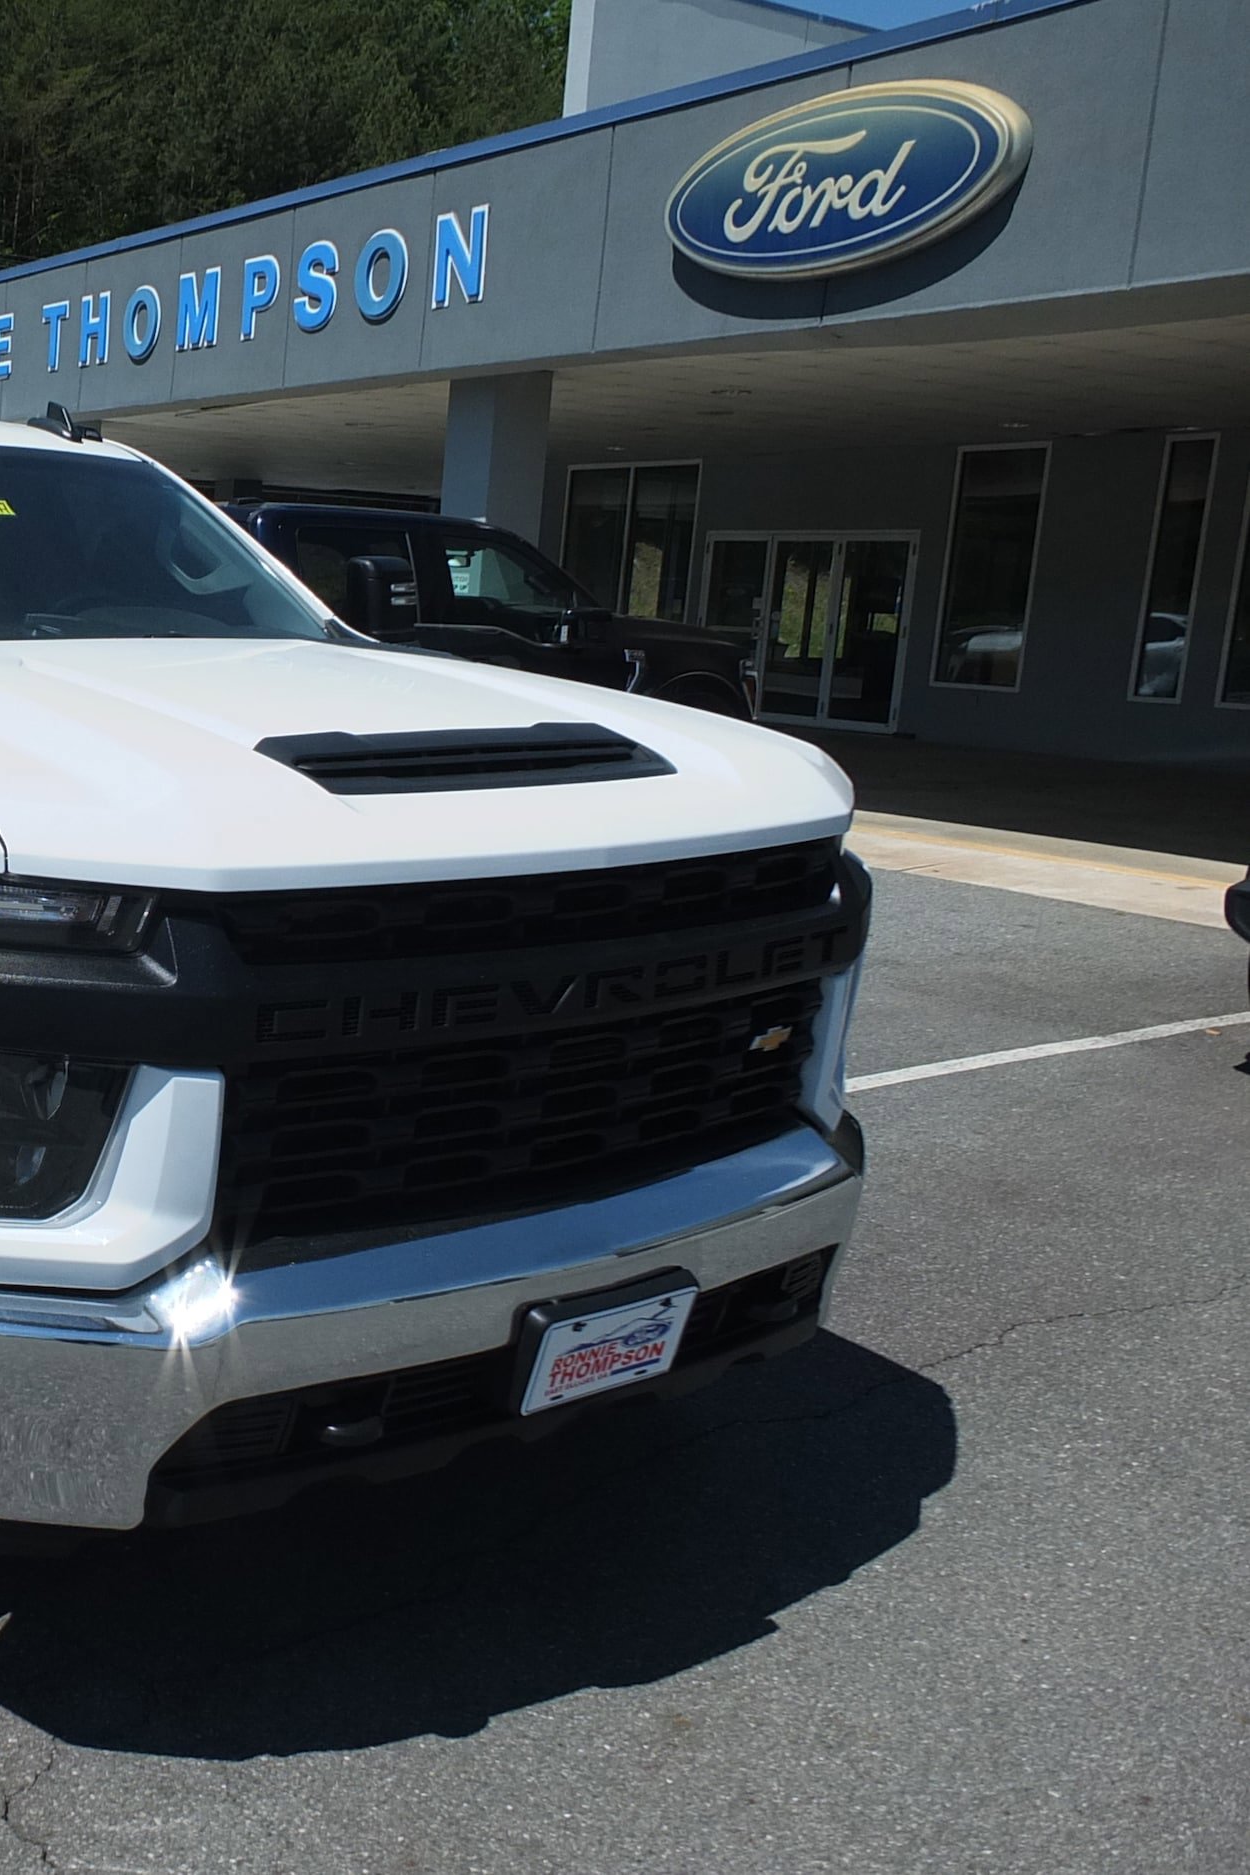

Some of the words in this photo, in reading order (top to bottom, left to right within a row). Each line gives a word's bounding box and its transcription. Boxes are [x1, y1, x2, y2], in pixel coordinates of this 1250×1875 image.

[724, 130, 916, 243] Ford
[42, 204, 490, 371] THOMPSON
[256, 926, 847, 1043] CHEVROLET
[549, 1341, 666, 1387] THOMPSON
[552, 1342, 618, 1372] RONNIE
